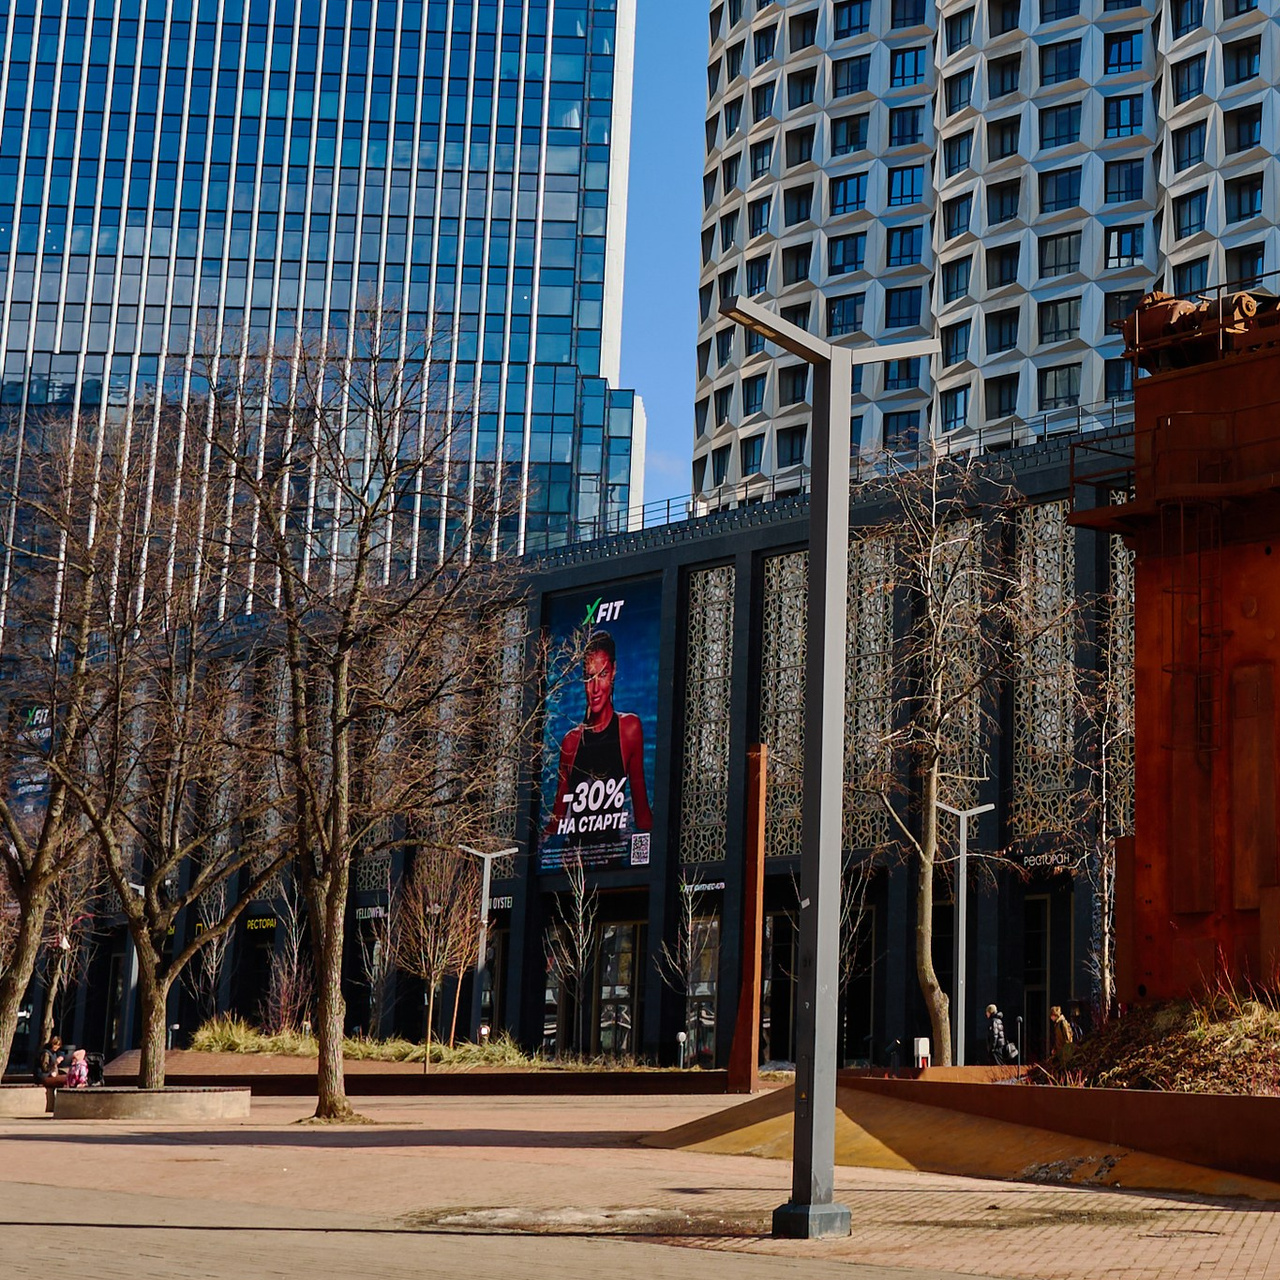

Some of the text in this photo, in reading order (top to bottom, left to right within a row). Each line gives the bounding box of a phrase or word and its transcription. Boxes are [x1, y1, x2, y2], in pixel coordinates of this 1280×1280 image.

[581, 597, 625, 626] XFIT
[562, 776, 628, 813] -30%
[557, 812, 629, 835] НА СТАРТЕ
